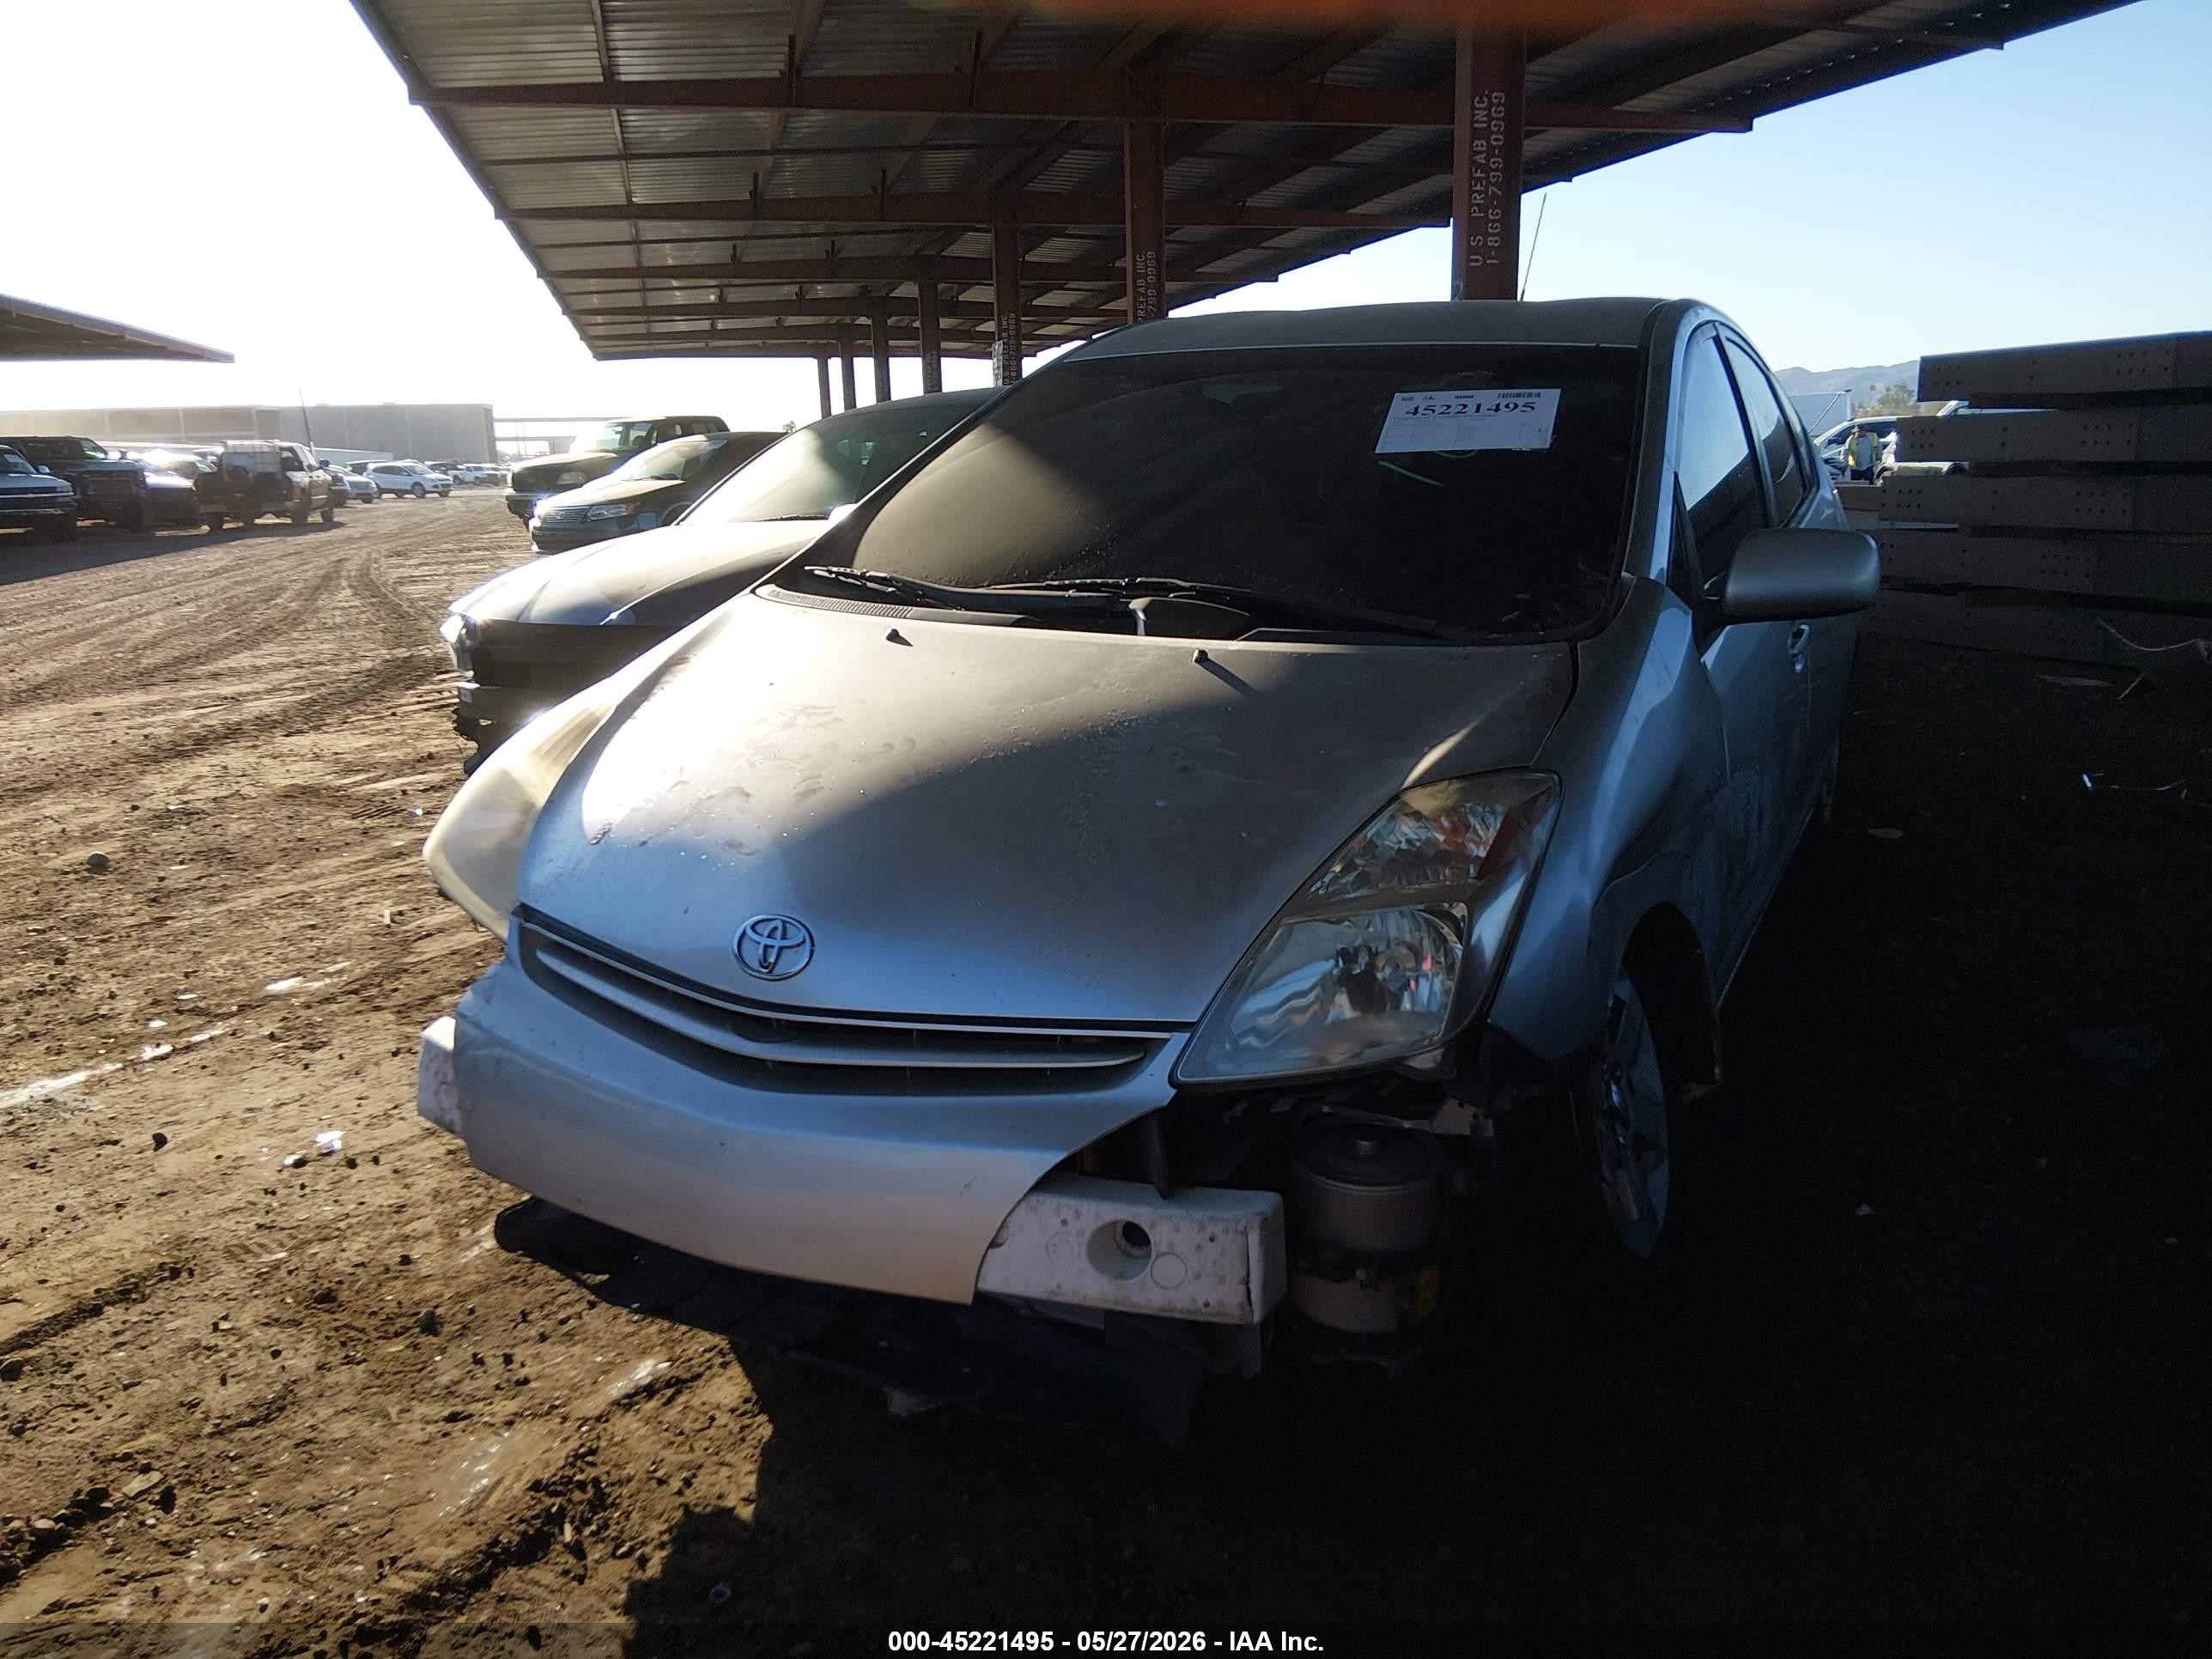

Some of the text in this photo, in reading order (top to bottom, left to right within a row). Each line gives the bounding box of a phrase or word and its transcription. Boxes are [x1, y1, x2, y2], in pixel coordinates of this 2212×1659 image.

[1474, 89, 1488, 128] INC.
[1471, 139, 1486, 217] PREFAB
[1486, 91, 1504, 264] 1-866-799-0969
[1146, 251, 1157, 319] -799-0969
[1405, 401, 1537, 416] 45221495
